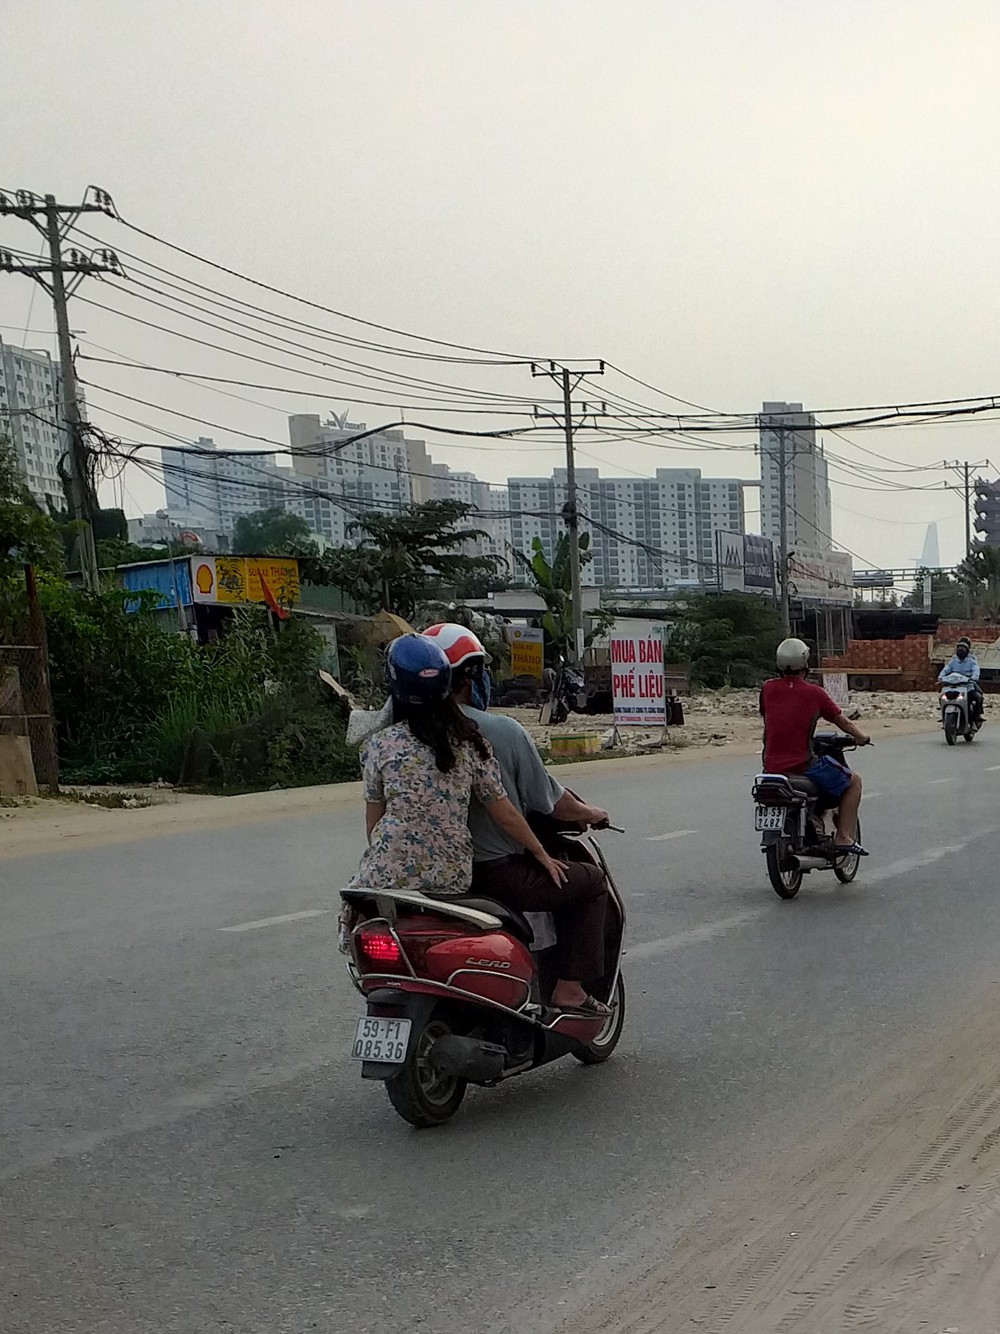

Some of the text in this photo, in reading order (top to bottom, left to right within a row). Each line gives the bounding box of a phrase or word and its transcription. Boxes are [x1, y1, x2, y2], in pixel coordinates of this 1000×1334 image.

[611, 634, 662, 663] MUA BÁN
[613, 667, 663, 703] PHẾ LIỆU
[362, 1020, 401, 1040] 59-F1
[355, 1039, 404, 1060] 085.36
